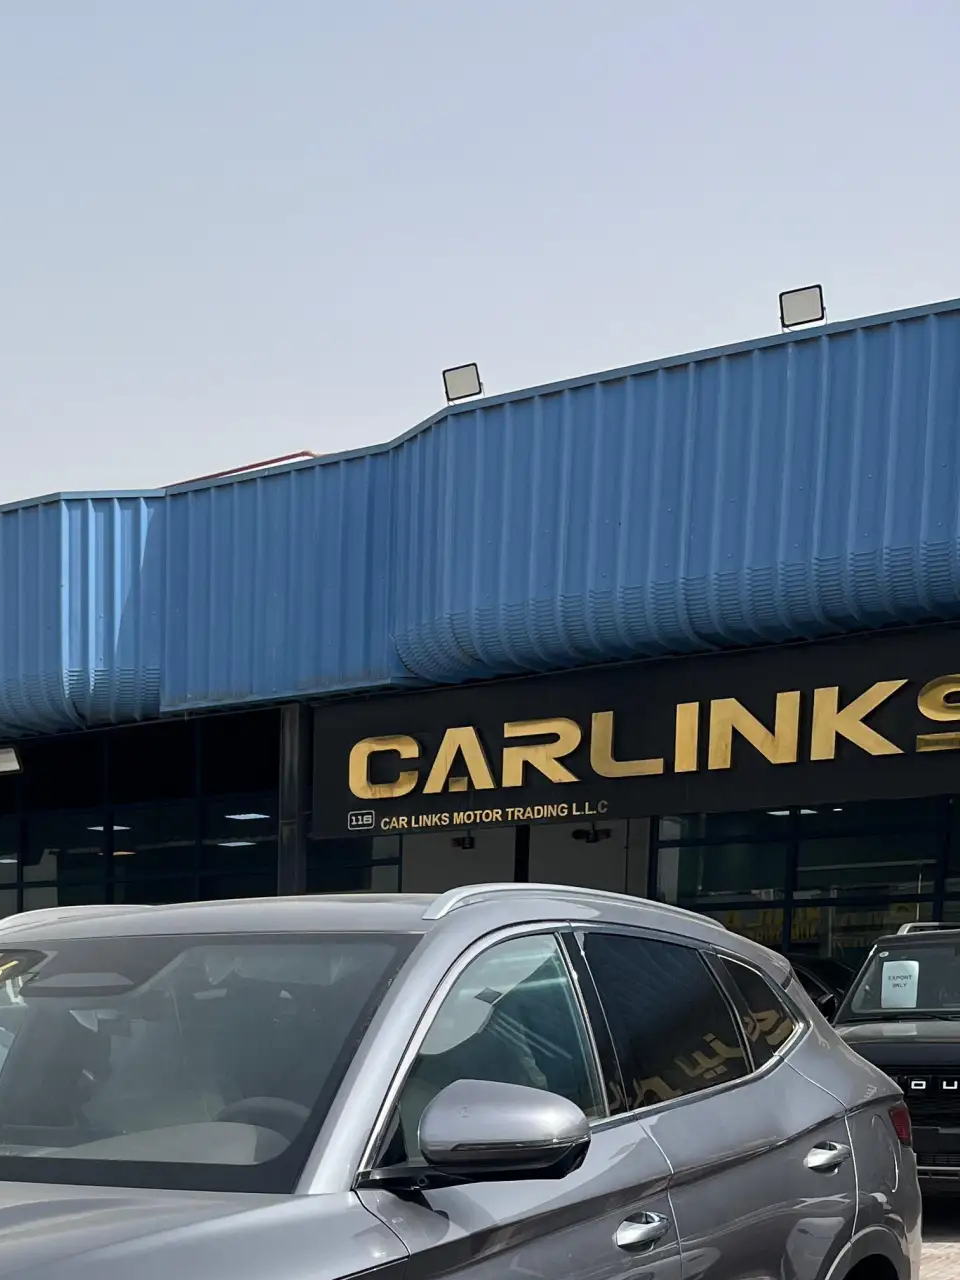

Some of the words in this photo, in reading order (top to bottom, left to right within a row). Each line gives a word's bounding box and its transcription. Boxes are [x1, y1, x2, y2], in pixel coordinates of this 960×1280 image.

[380, 815, 408, 830] CAR
[411, 812, 450, 828] LINKS
[453, 808, 502, 825] MOTOR
[505, 803, 568, 821] TRADING
